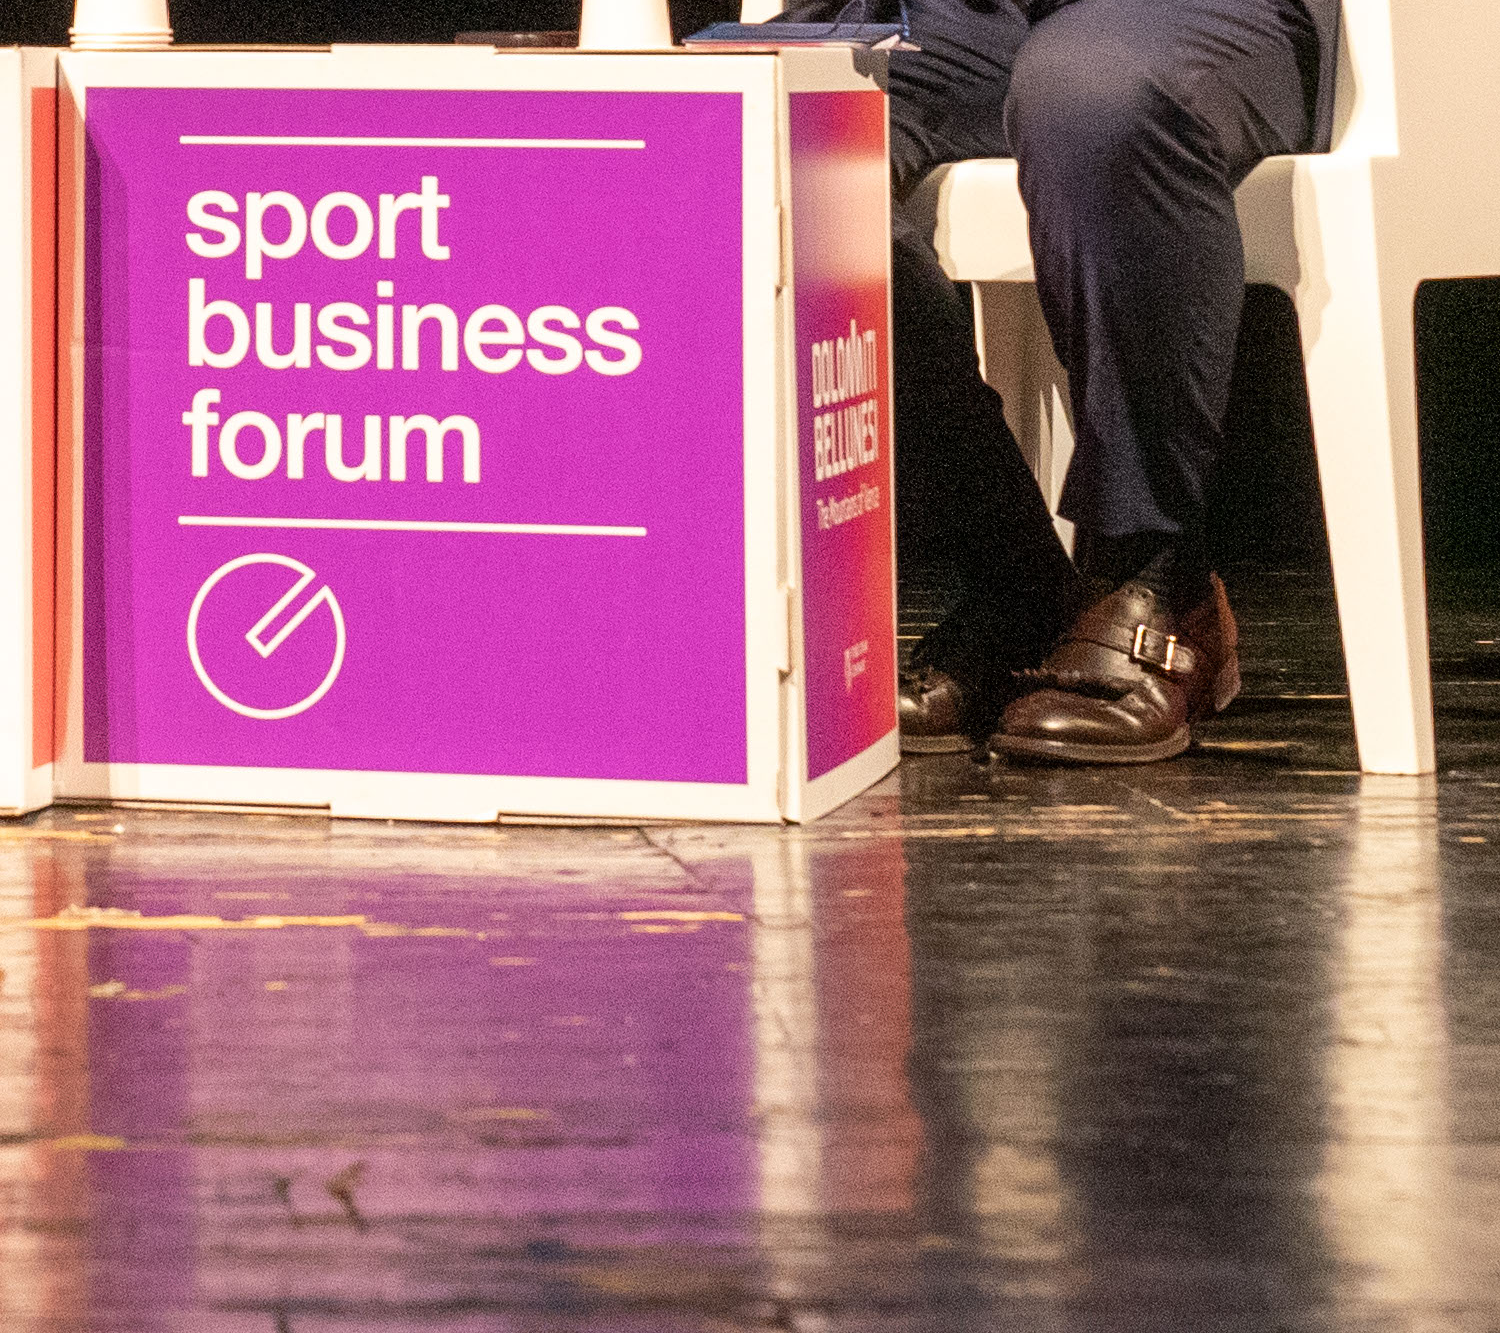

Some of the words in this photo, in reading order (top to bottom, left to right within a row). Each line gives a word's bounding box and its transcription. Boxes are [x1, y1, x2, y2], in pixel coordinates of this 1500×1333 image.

[185, 175, 451, 280] sport
[188, 278, 643, 376] business
[811, 319, 878, 409] DOLOMITI
[181, 388, 481, 484] forum
[814, 399, 879, 482] BELLUNESI
